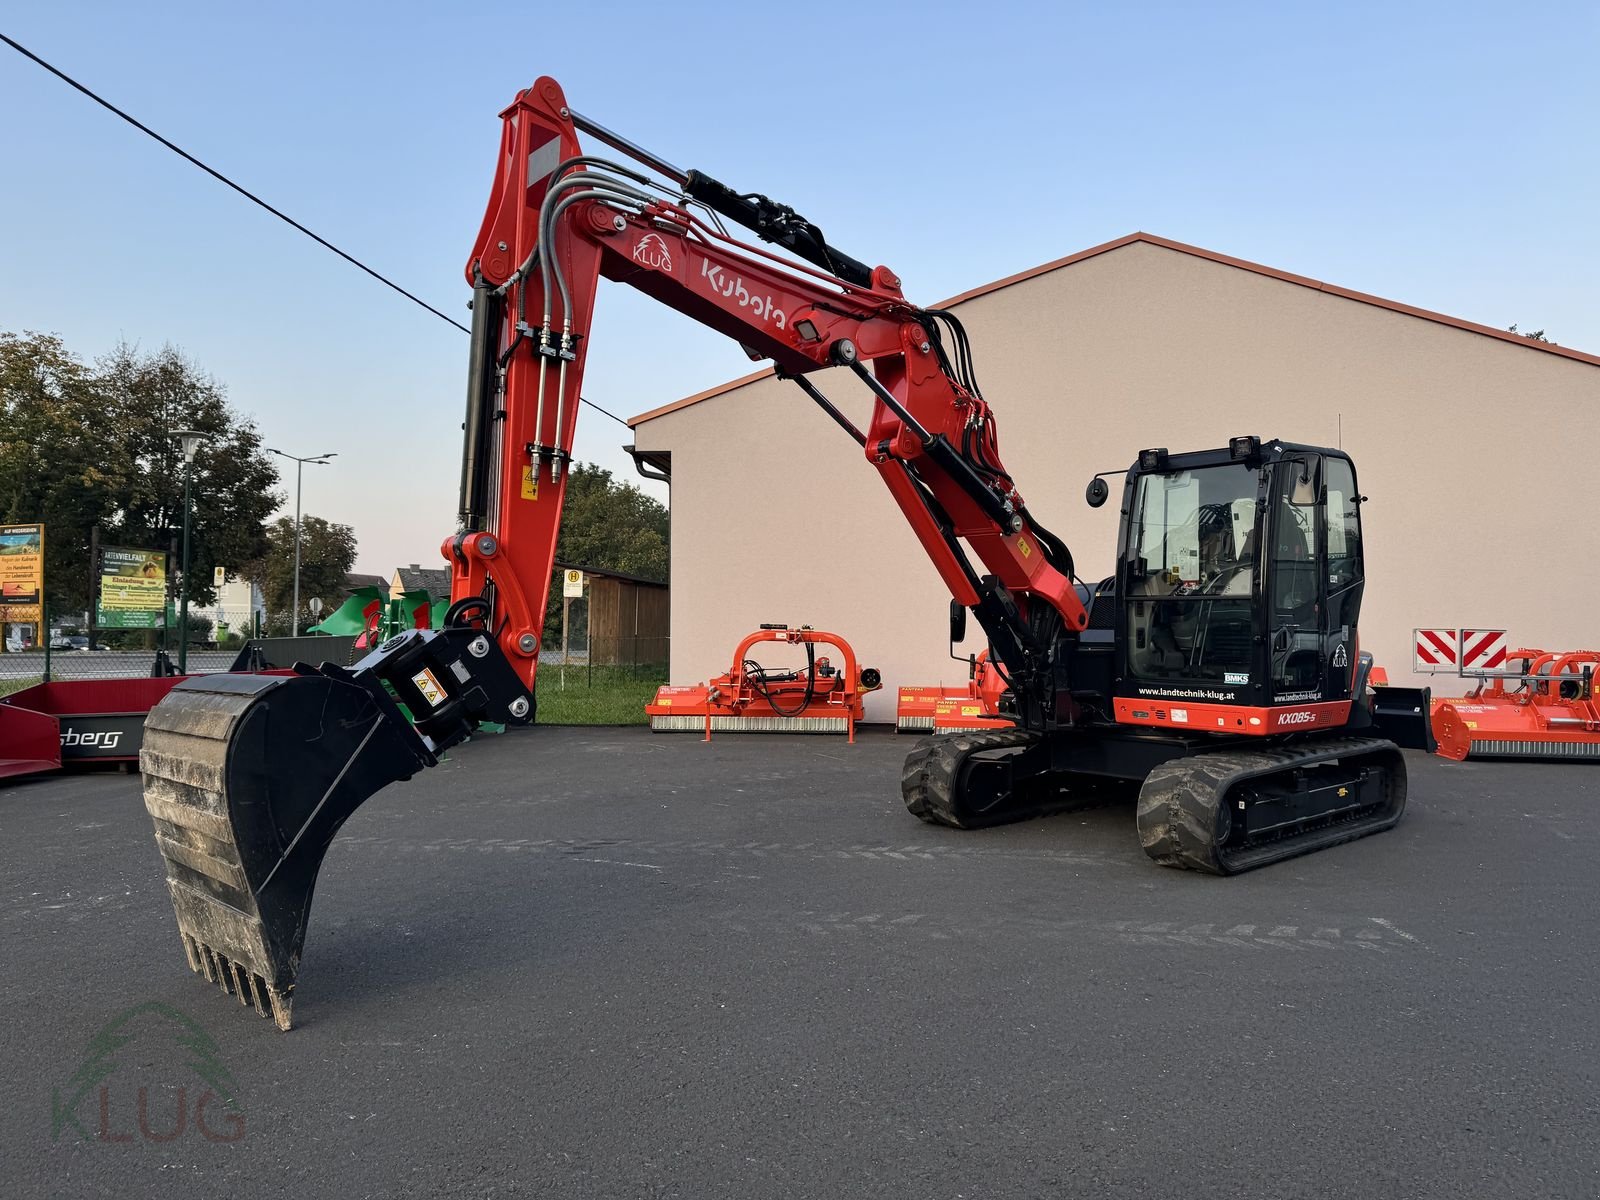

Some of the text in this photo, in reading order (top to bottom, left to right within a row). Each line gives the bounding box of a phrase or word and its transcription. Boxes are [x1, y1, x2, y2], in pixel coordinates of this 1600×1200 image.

[633, 244, 672, 272] KLUG
[701, 257, 786, 330] Kubota
[1333, 658, 1348, 667] KLUG
[1224, 673, 1249, 683] BMKS
[1138, 687, 1236, 701] www.landtechnik-klug.at
